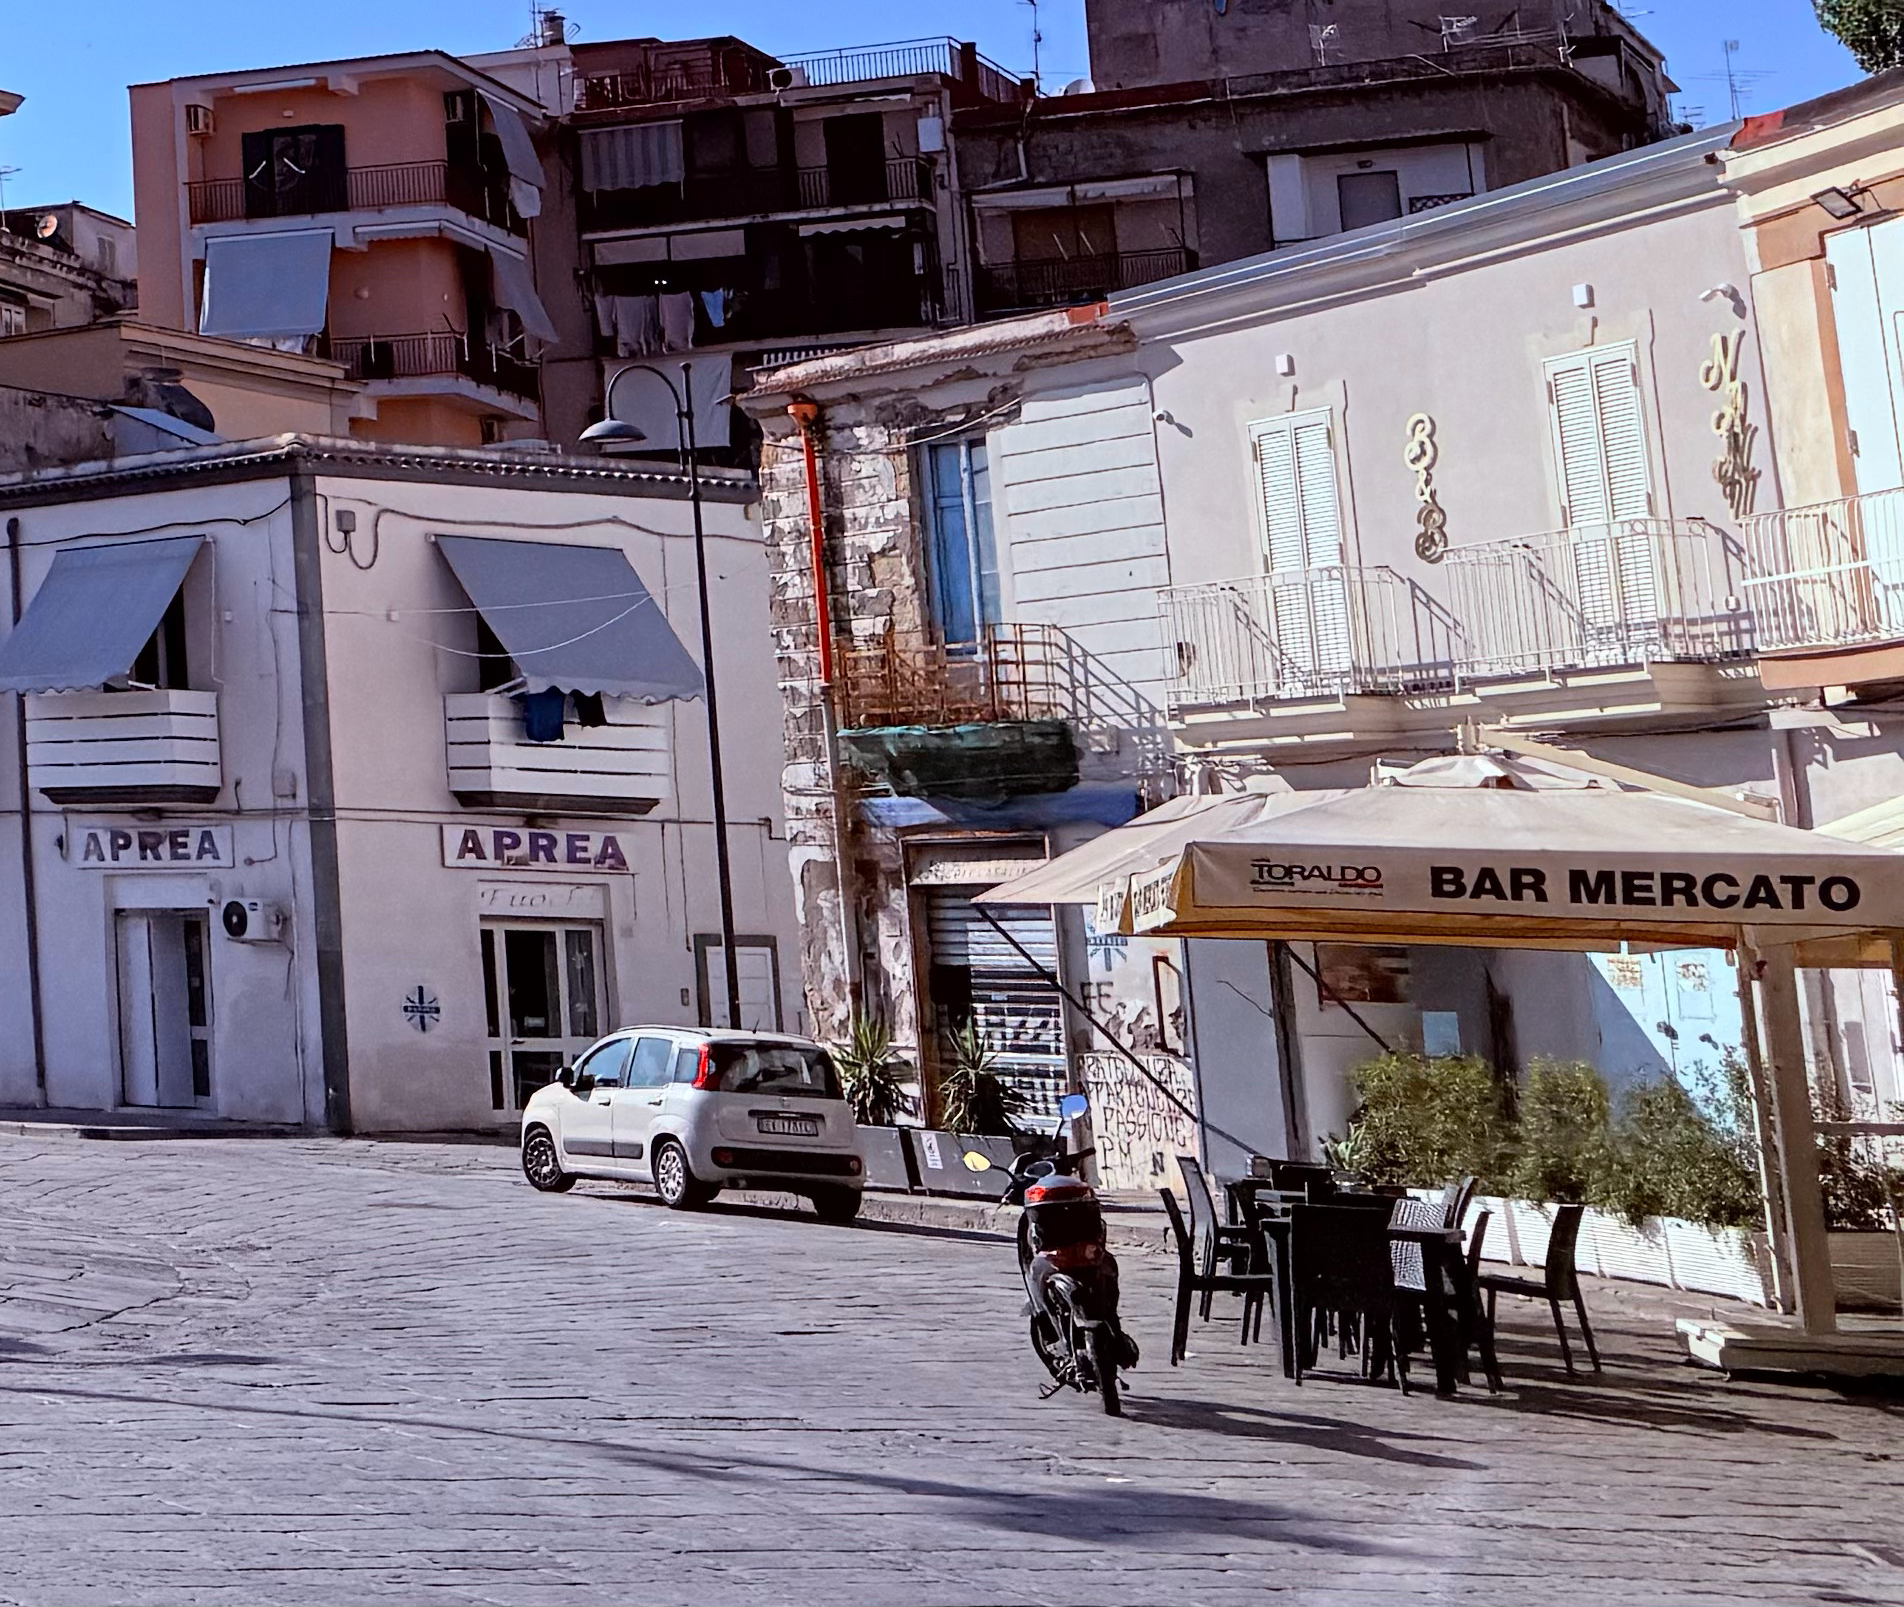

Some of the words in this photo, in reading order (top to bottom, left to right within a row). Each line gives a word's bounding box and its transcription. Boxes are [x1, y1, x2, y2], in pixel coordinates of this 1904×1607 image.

[82, 829, 221, 862] APREA
[456, 829, 629, 871] APREA
[1251, 863, 1382, 883] TORALDO
[1429, 865, 1549, 903] BAR
[1568, 868, 1862, 912] MERCATO
